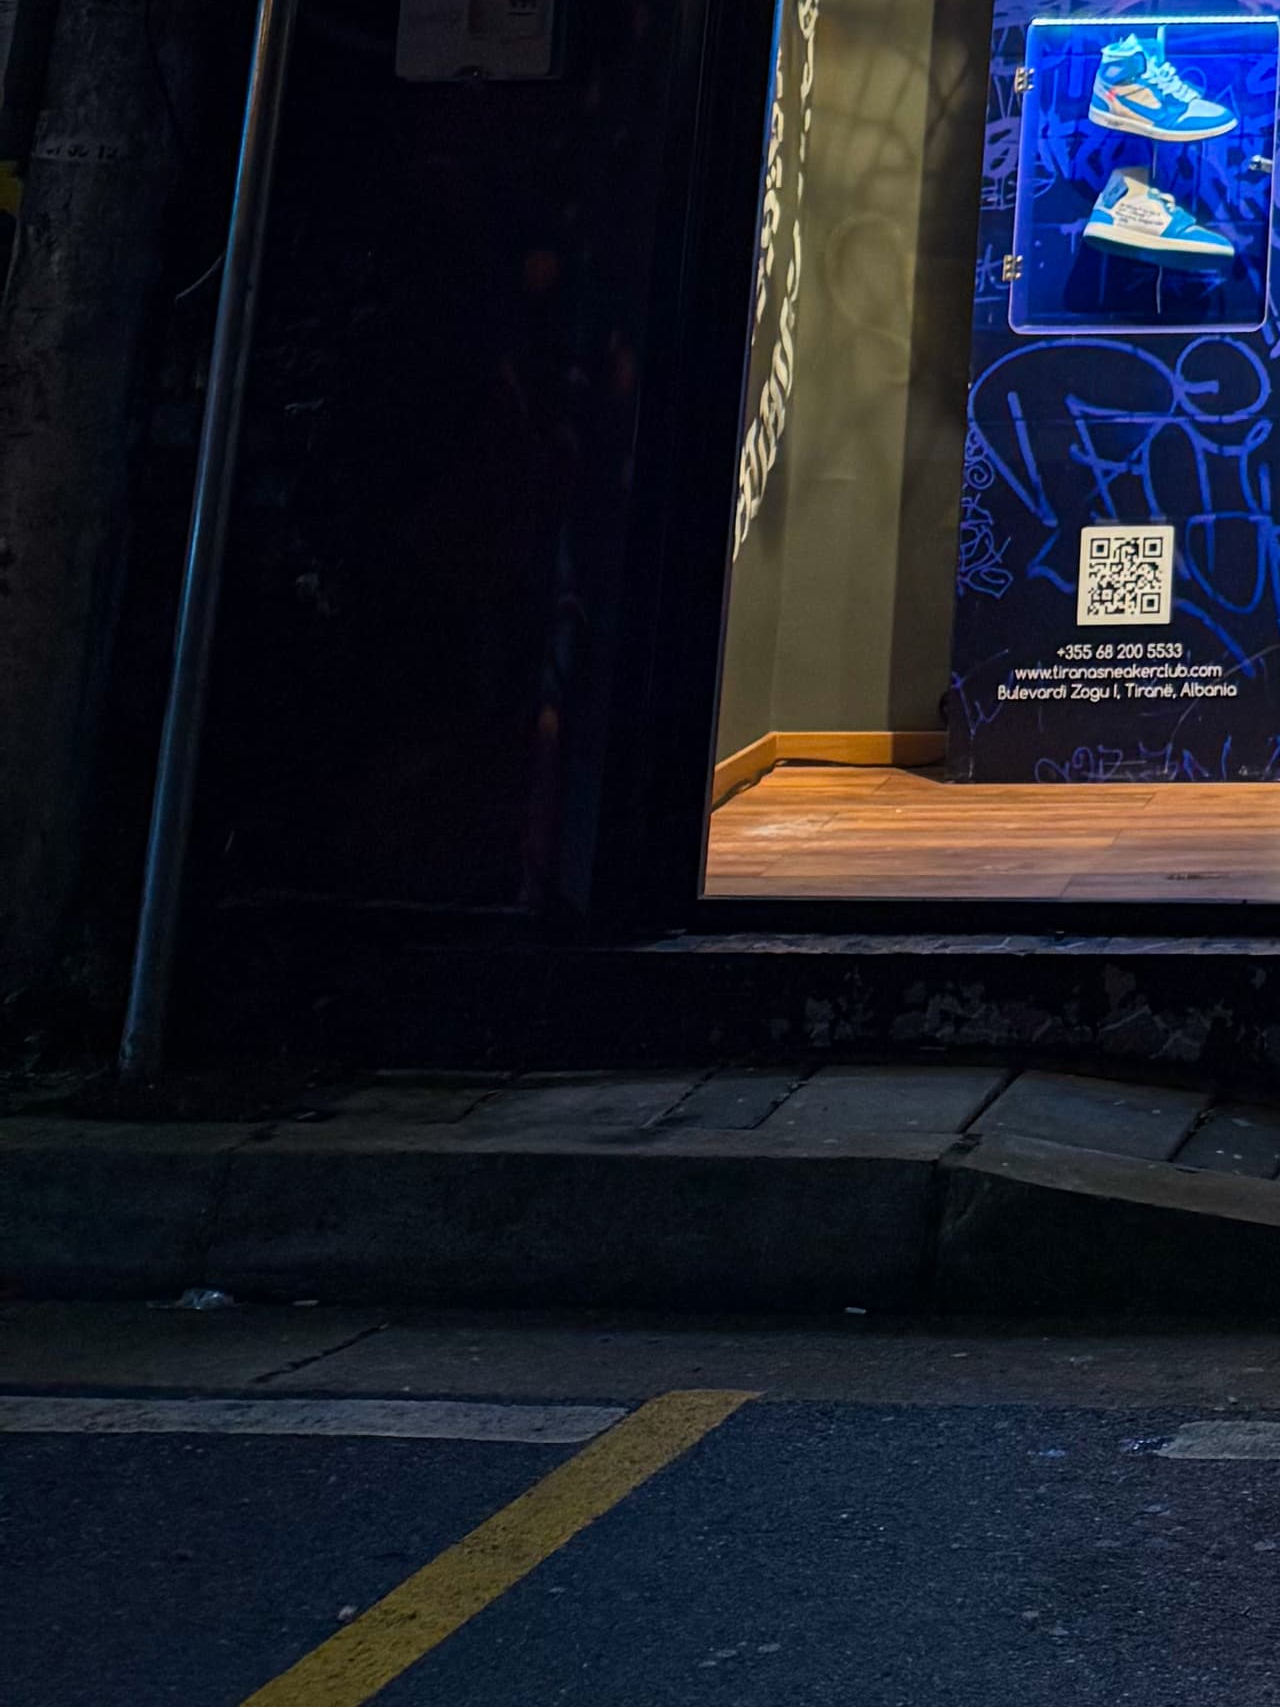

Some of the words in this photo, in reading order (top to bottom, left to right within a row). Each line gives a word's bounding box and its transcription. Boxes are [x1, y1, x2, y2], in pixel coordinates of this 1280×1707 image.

[1057, 643, 1092, 660] +355
[1096, 643, 1114, 660] 68
[1116, 643, 1143, 660] 200
[1146, 642, 1183, 659] 5533
[1014, 663, 1223, 680] www.tiranasneakerclub.com
[997, 683, 1068, 701] Bulevardi
[1070, 683, 1110, 703] Zogu
[1124, 682, 1177, 700] Tiranë,
[1179, 682, 1238, 699] Albania
